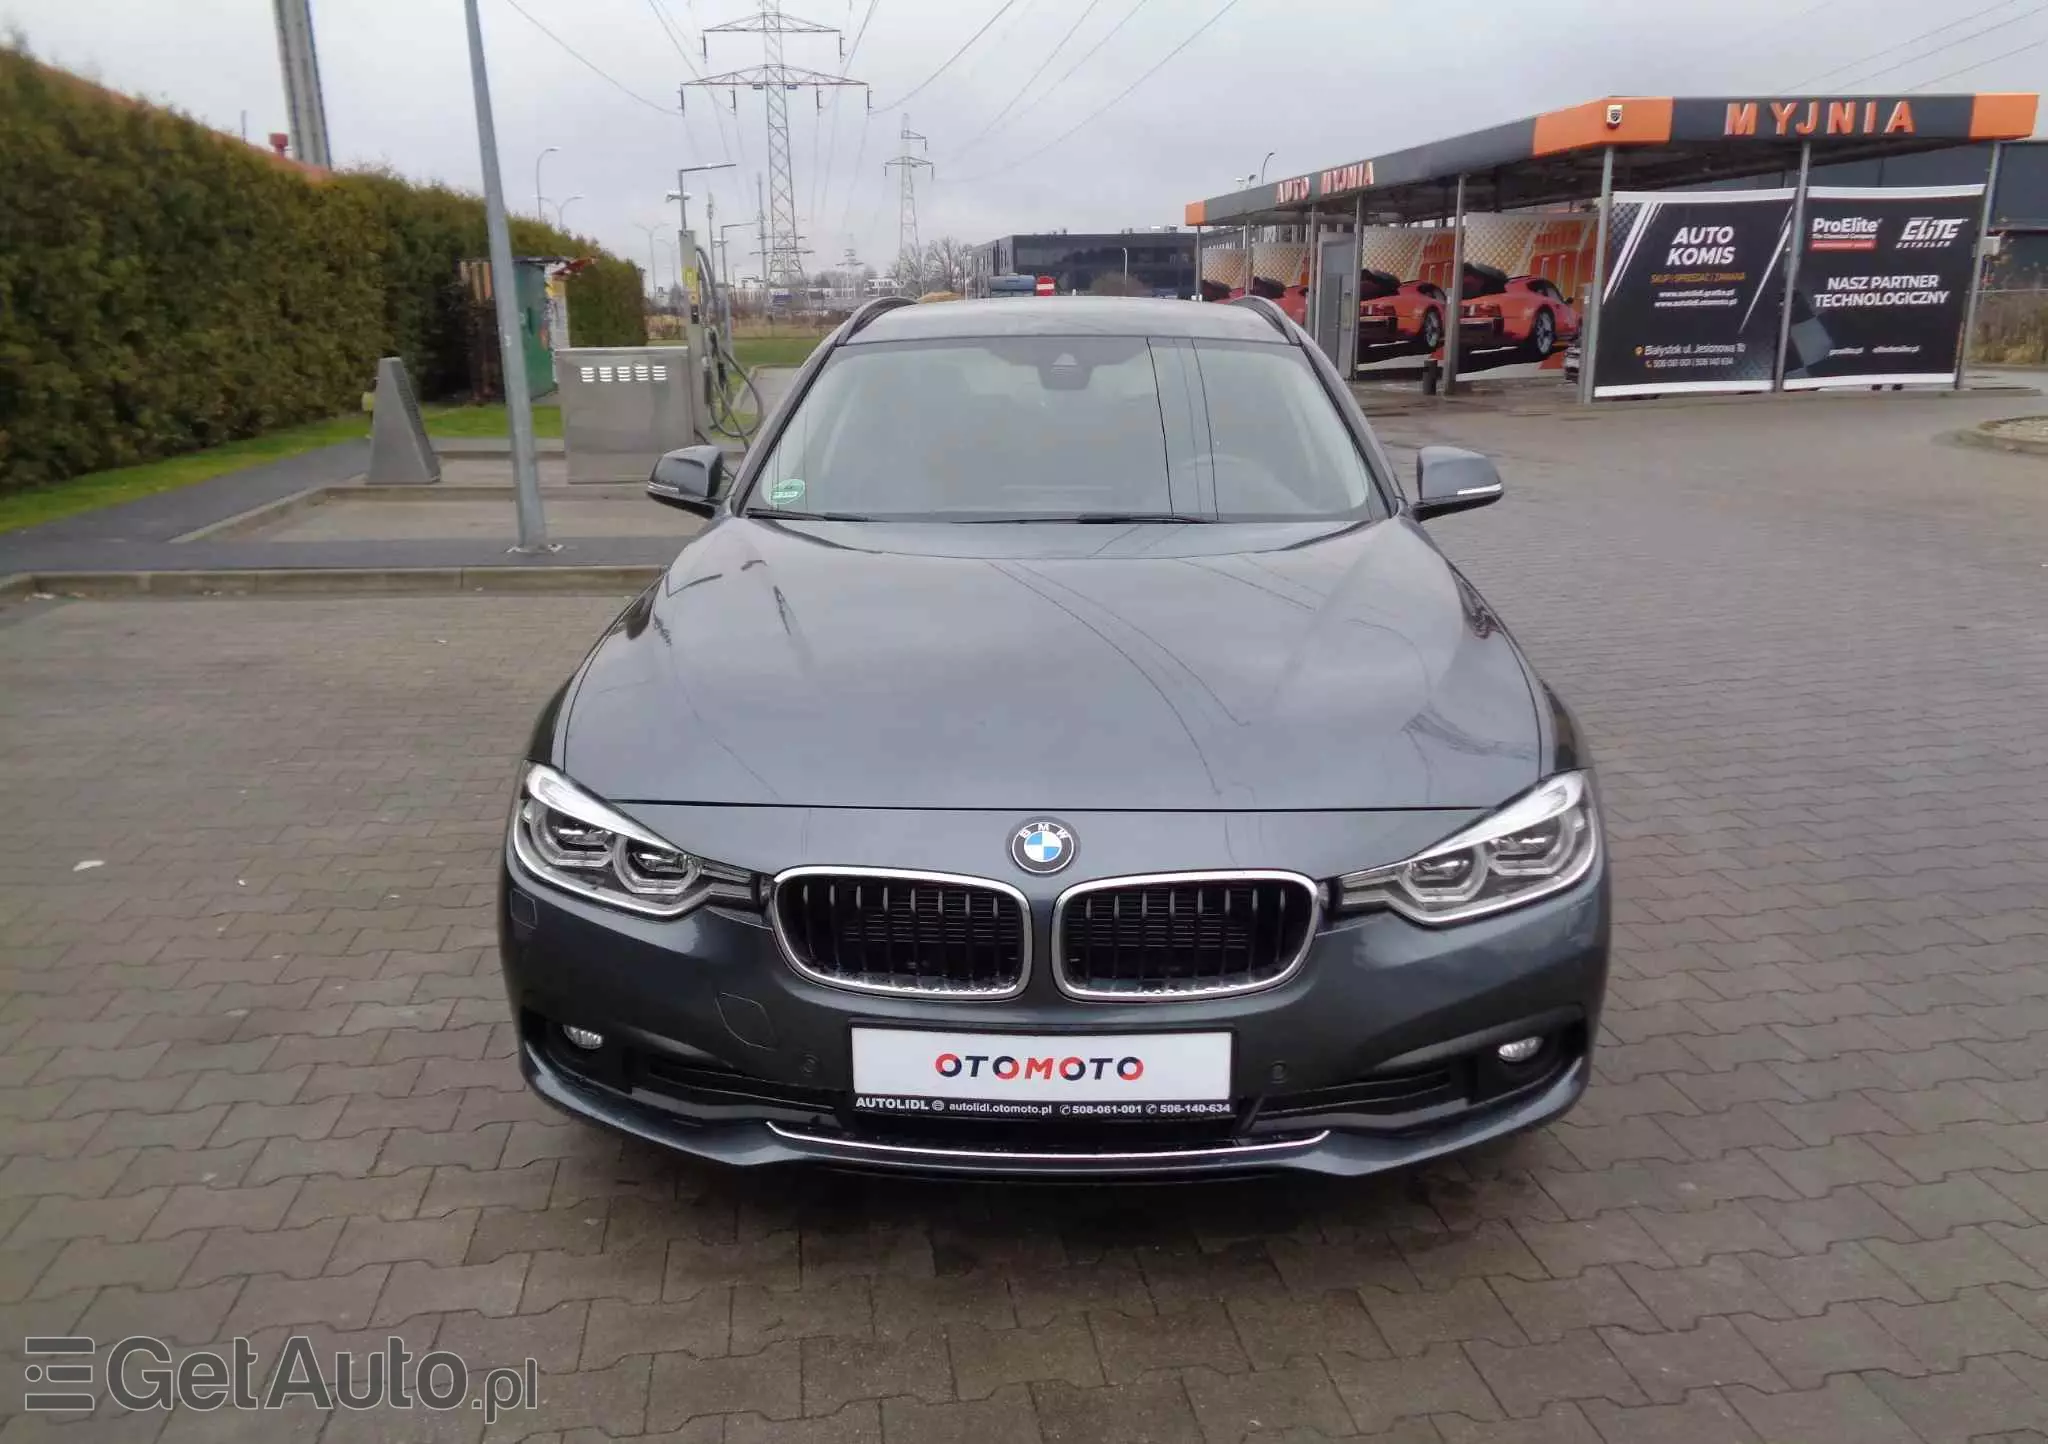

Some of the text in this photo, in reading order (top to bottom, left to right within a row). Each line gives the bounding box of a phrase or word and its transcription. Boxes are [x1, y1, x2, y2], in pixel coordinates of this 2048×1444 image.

[1724, 101, 1916, 135] MYJNIA
[1812, 216, 1878, 233] ProElite
[1672, 226, 1734, 245] AUTO
[1666, 247, 1736, 266] KOMIS
[1827, 274, 1940, 290] NASZ PARTNER
[1814, 291, 1950, 308] TECHNOLOGICZNY
[1019, 822, 1071, 839] BMW
[935, 1053, 1144, 1081] OTOMOTO
[856, 1097, 929, 1110] AUTOLIDL
[949, 1102, 1052, 1116] autolidl.otomoto.pl
